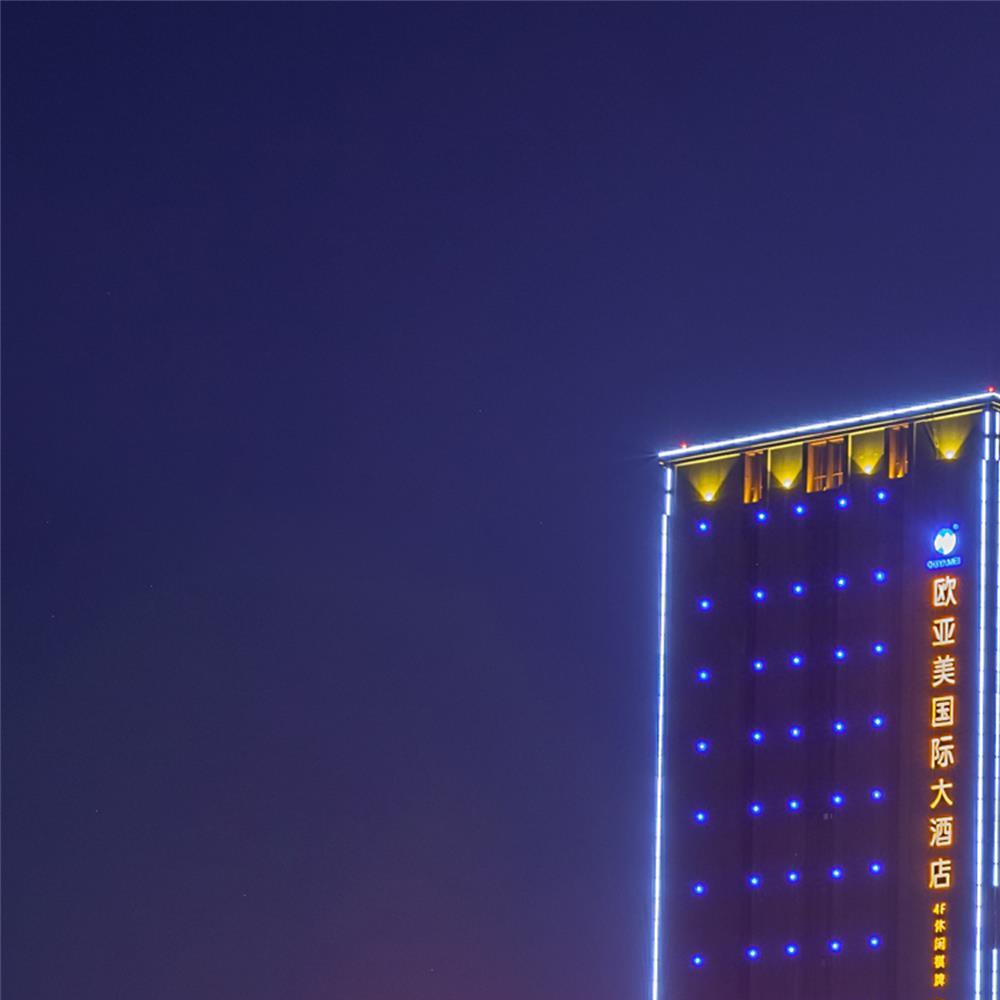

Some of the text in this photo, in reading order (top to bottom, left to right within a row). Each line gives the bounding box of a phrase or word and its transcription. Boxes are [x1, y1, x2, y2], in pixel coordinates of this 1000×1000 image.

[929, 575, 958, 889] 欧亚美国际大酒店
